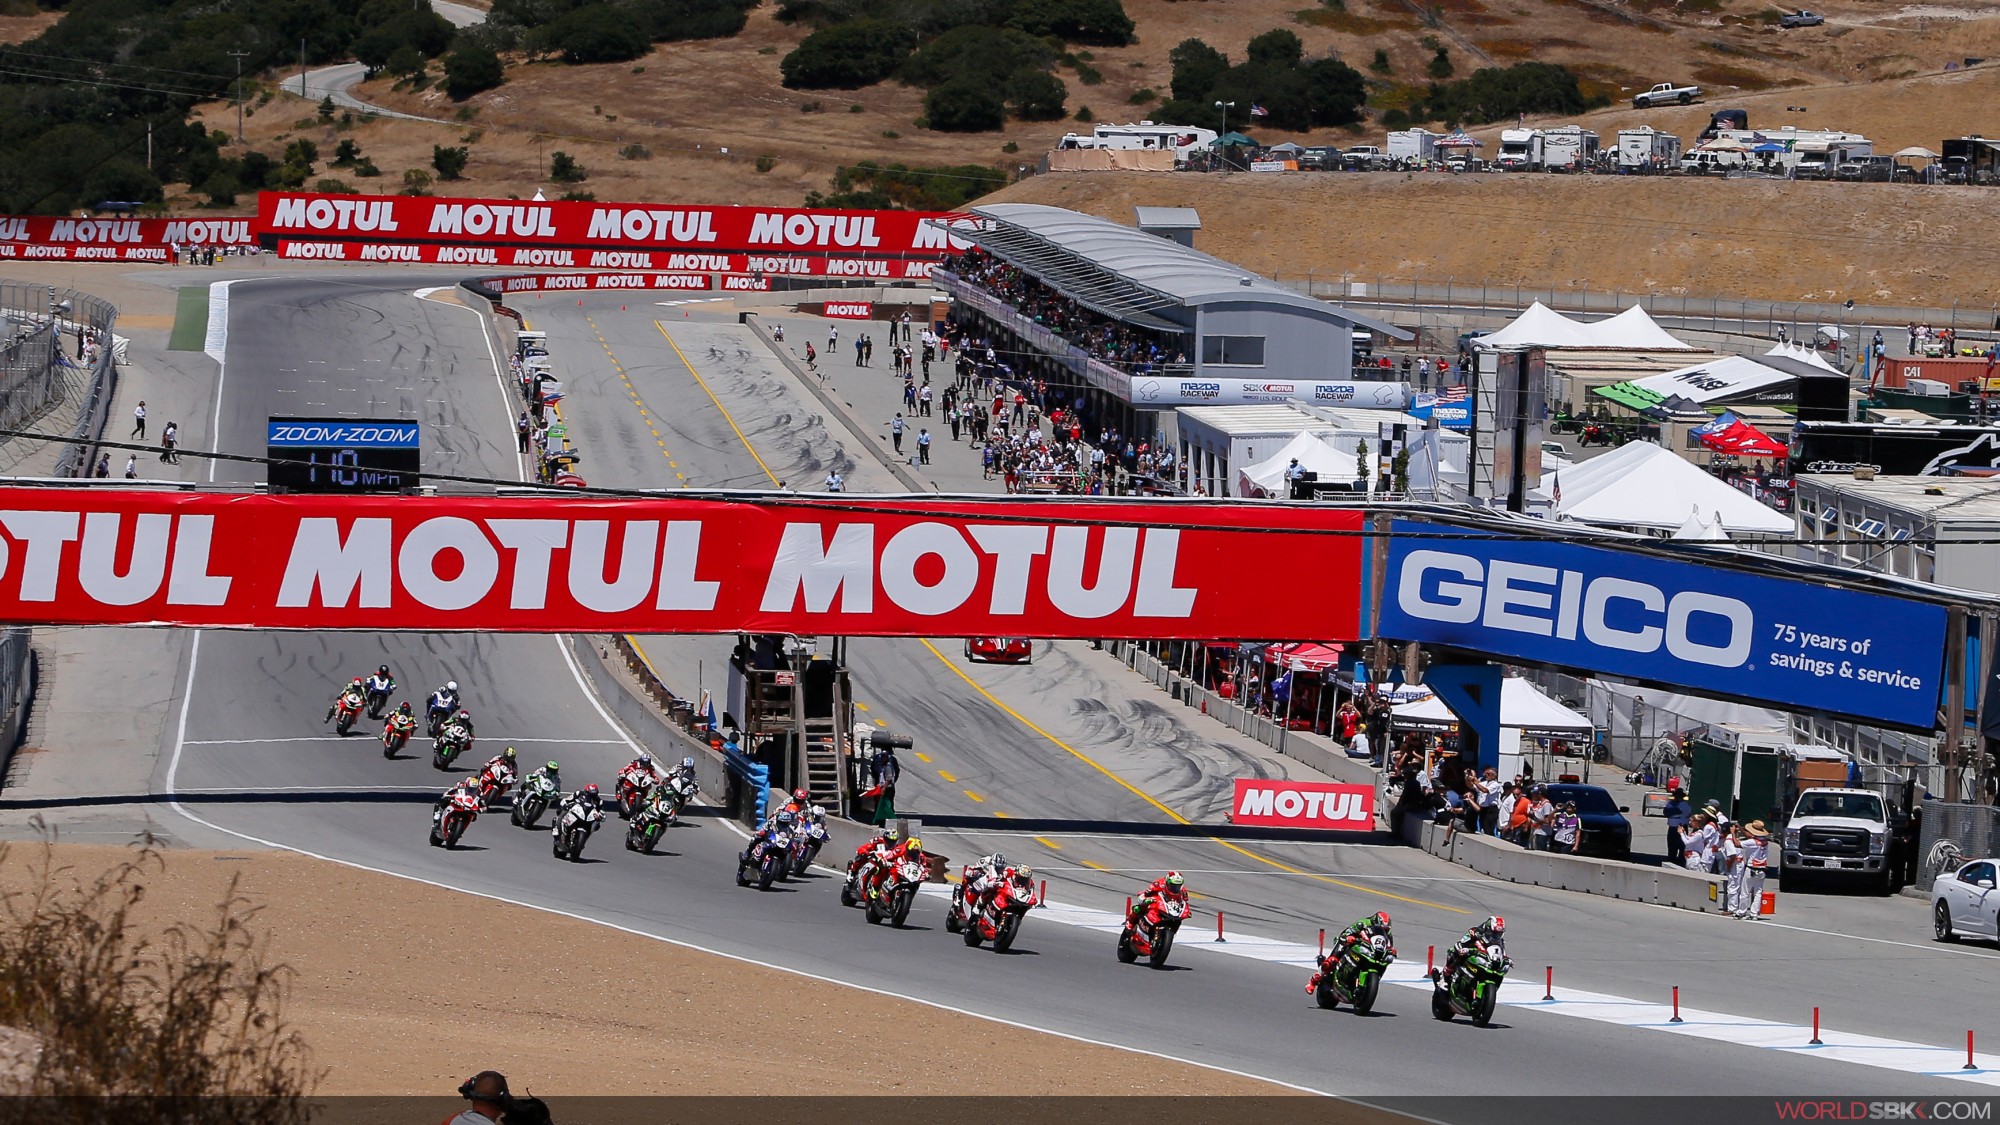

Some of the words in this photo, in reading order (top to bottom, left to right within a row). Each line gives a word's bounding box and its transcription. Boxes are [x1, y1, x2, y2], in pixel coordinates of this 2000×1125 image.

[273, 199, 398, 231] MOTUL
[428, 204, 557, 237] MOTUL
[50, 220, 143, 243] MOTUL
[162, 221, 252, 243] MOTUL
[587, 208, 718, 242] MOTUL
[747, 213, 881, 247] MOTUL
[24, 246, 67, 259] MOTUL
[74, 247, 118, 259] MOTUL
[125, 248, 167, 260] MOTUL
[285, 242, 346, 259] MOTUL
[361, 244, 422, 261] MOTUL
[437, 246, 498, 264] MOTUL
[513, 249, 574, 266] MOTUL
[590, 251, 652, 268] MOTUL
[667, 254, 731, 271] MOTUL
[827, 259, 890, 277] MOTUL
[507, 278, 538, 291] MOTUL
[544, 277, 588, 289] MOTUL
[595, 275, 645, 289] MOTUL
[654, 275, 705, 289] MOTUL
[826, 304, 869, 317] MOTUL
[1904, 367, 1921, 377] CAI
[1180, 390, 1219, 398] RACEWAY
[1269, 385, 1293, 393] MOTUL
[1315, 392, 1355, 400] RACEWAY
[270, 427, 417, 442] ZOOM-ZOOM
[362, 472, 400, 485] MPH
[1769, 478, 1790, 488] SBK
[0, 509, 232, 606] TUL
[275, 516, 721, 612] MOTUL
[759, 521, 1198, 618] MOTUL
[1398, 548, 1754, 668] GEICO
[1774, 623, 1797, 643] 75
[1800, 631, 1847, 651] years
[1851, 639, 1871, 656] of
[1770, 652, 1835, 677] savings
[1838, 660, 1853, 679] &
[1857, 669, 1921, 690] service
[1240, 786, 1367, 821] MOTUL
